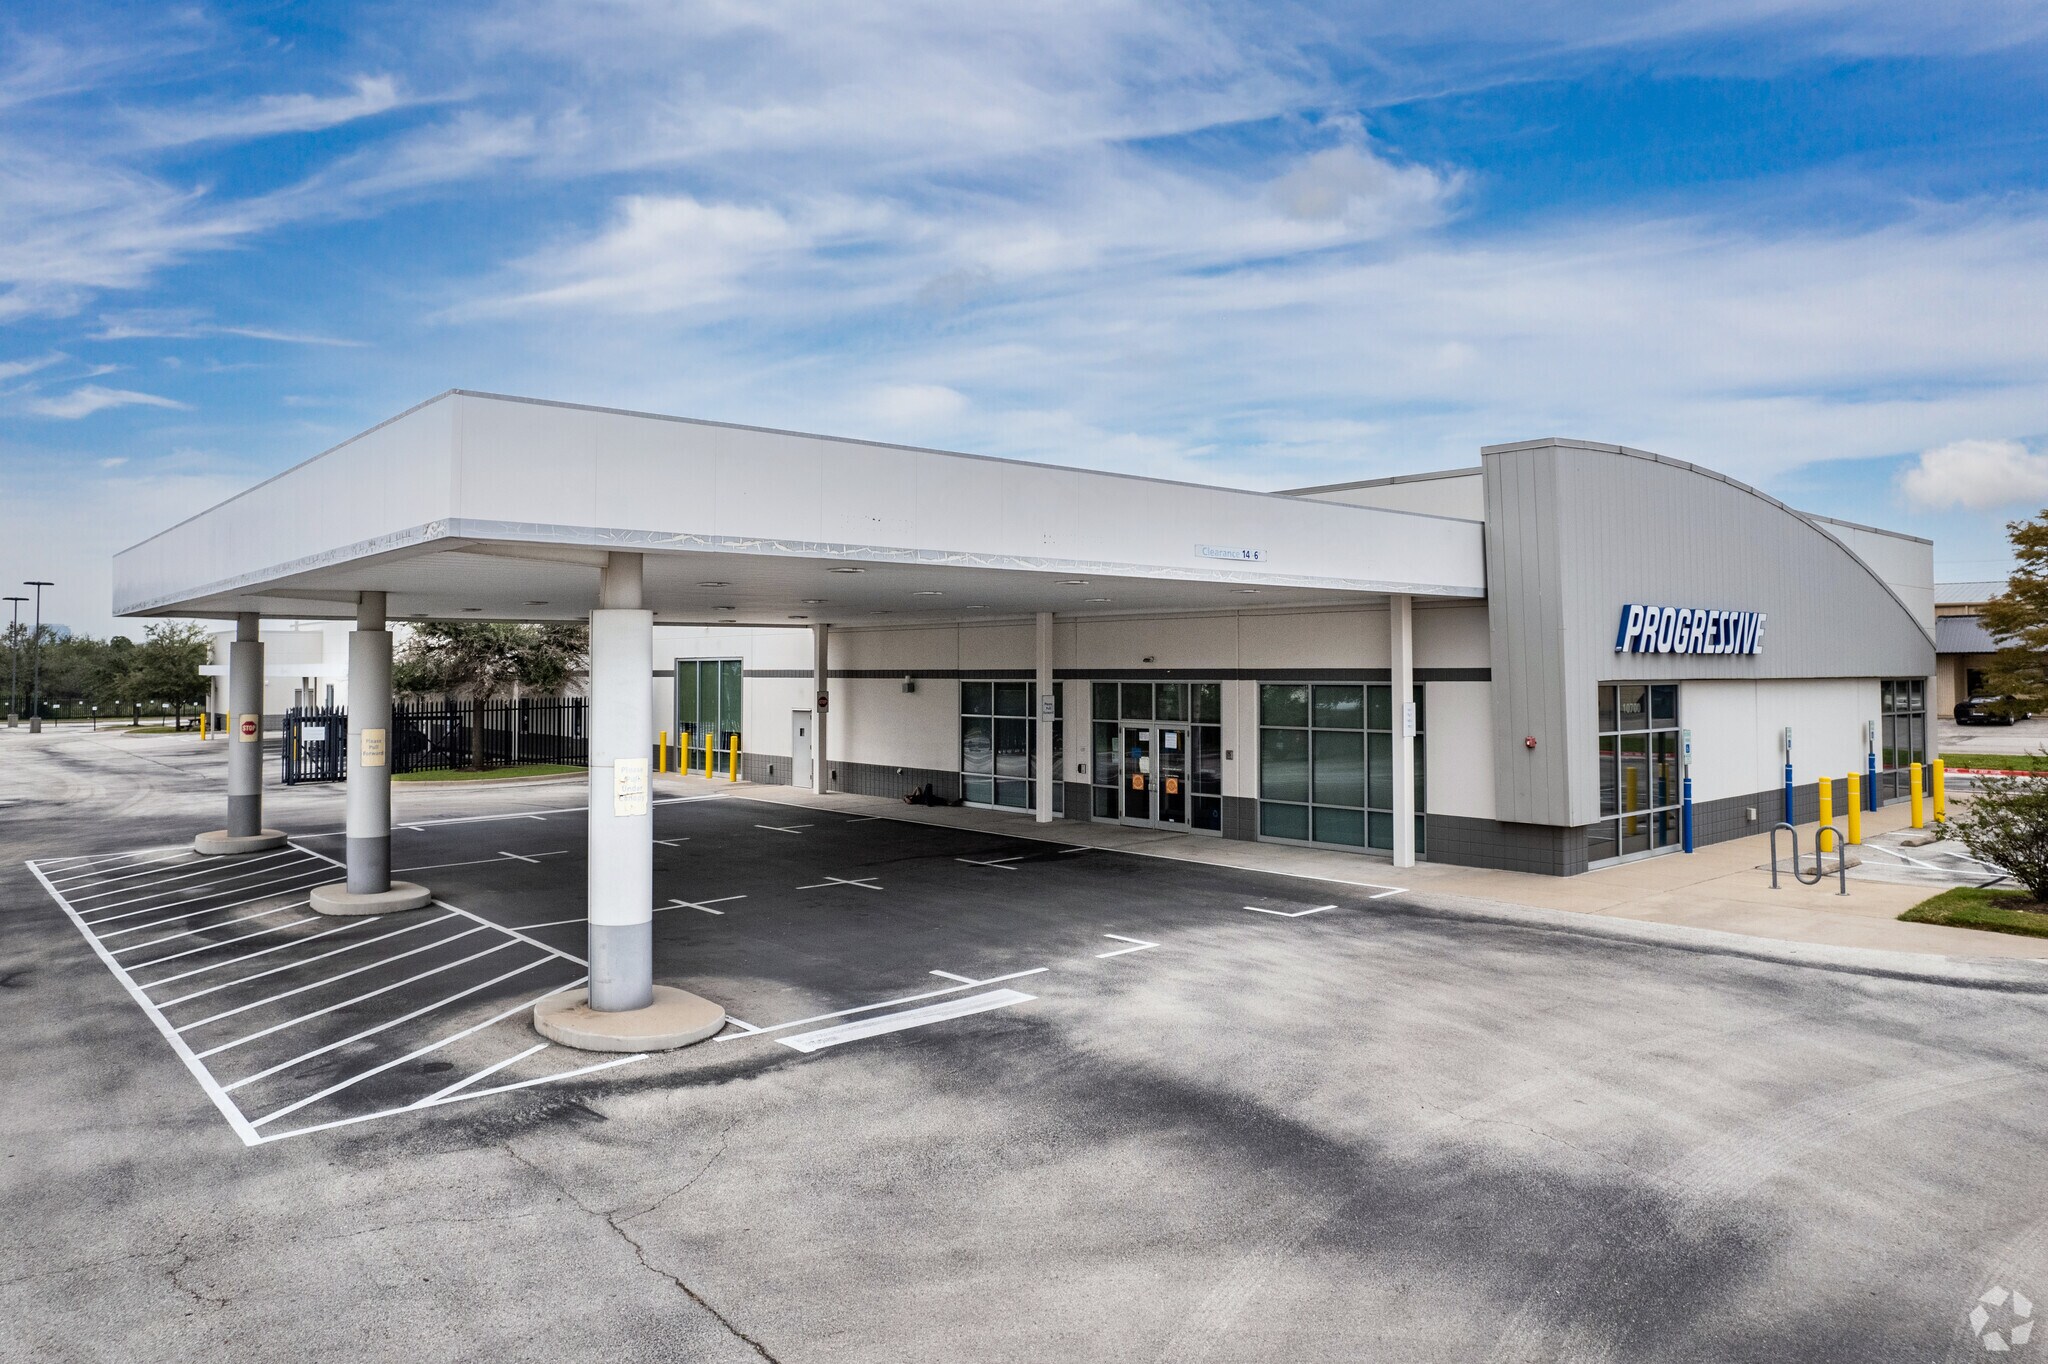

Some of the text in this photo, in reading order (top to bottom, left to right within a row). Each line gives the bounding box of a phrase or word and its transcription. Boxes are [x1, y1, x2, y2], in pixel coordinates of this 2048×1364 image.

[1202, 547, 1259, 560] Clearance 14 6
[1620, 604, 1767, 654] PROGRESSIVE
[242, 724, 256, 732] STOP
